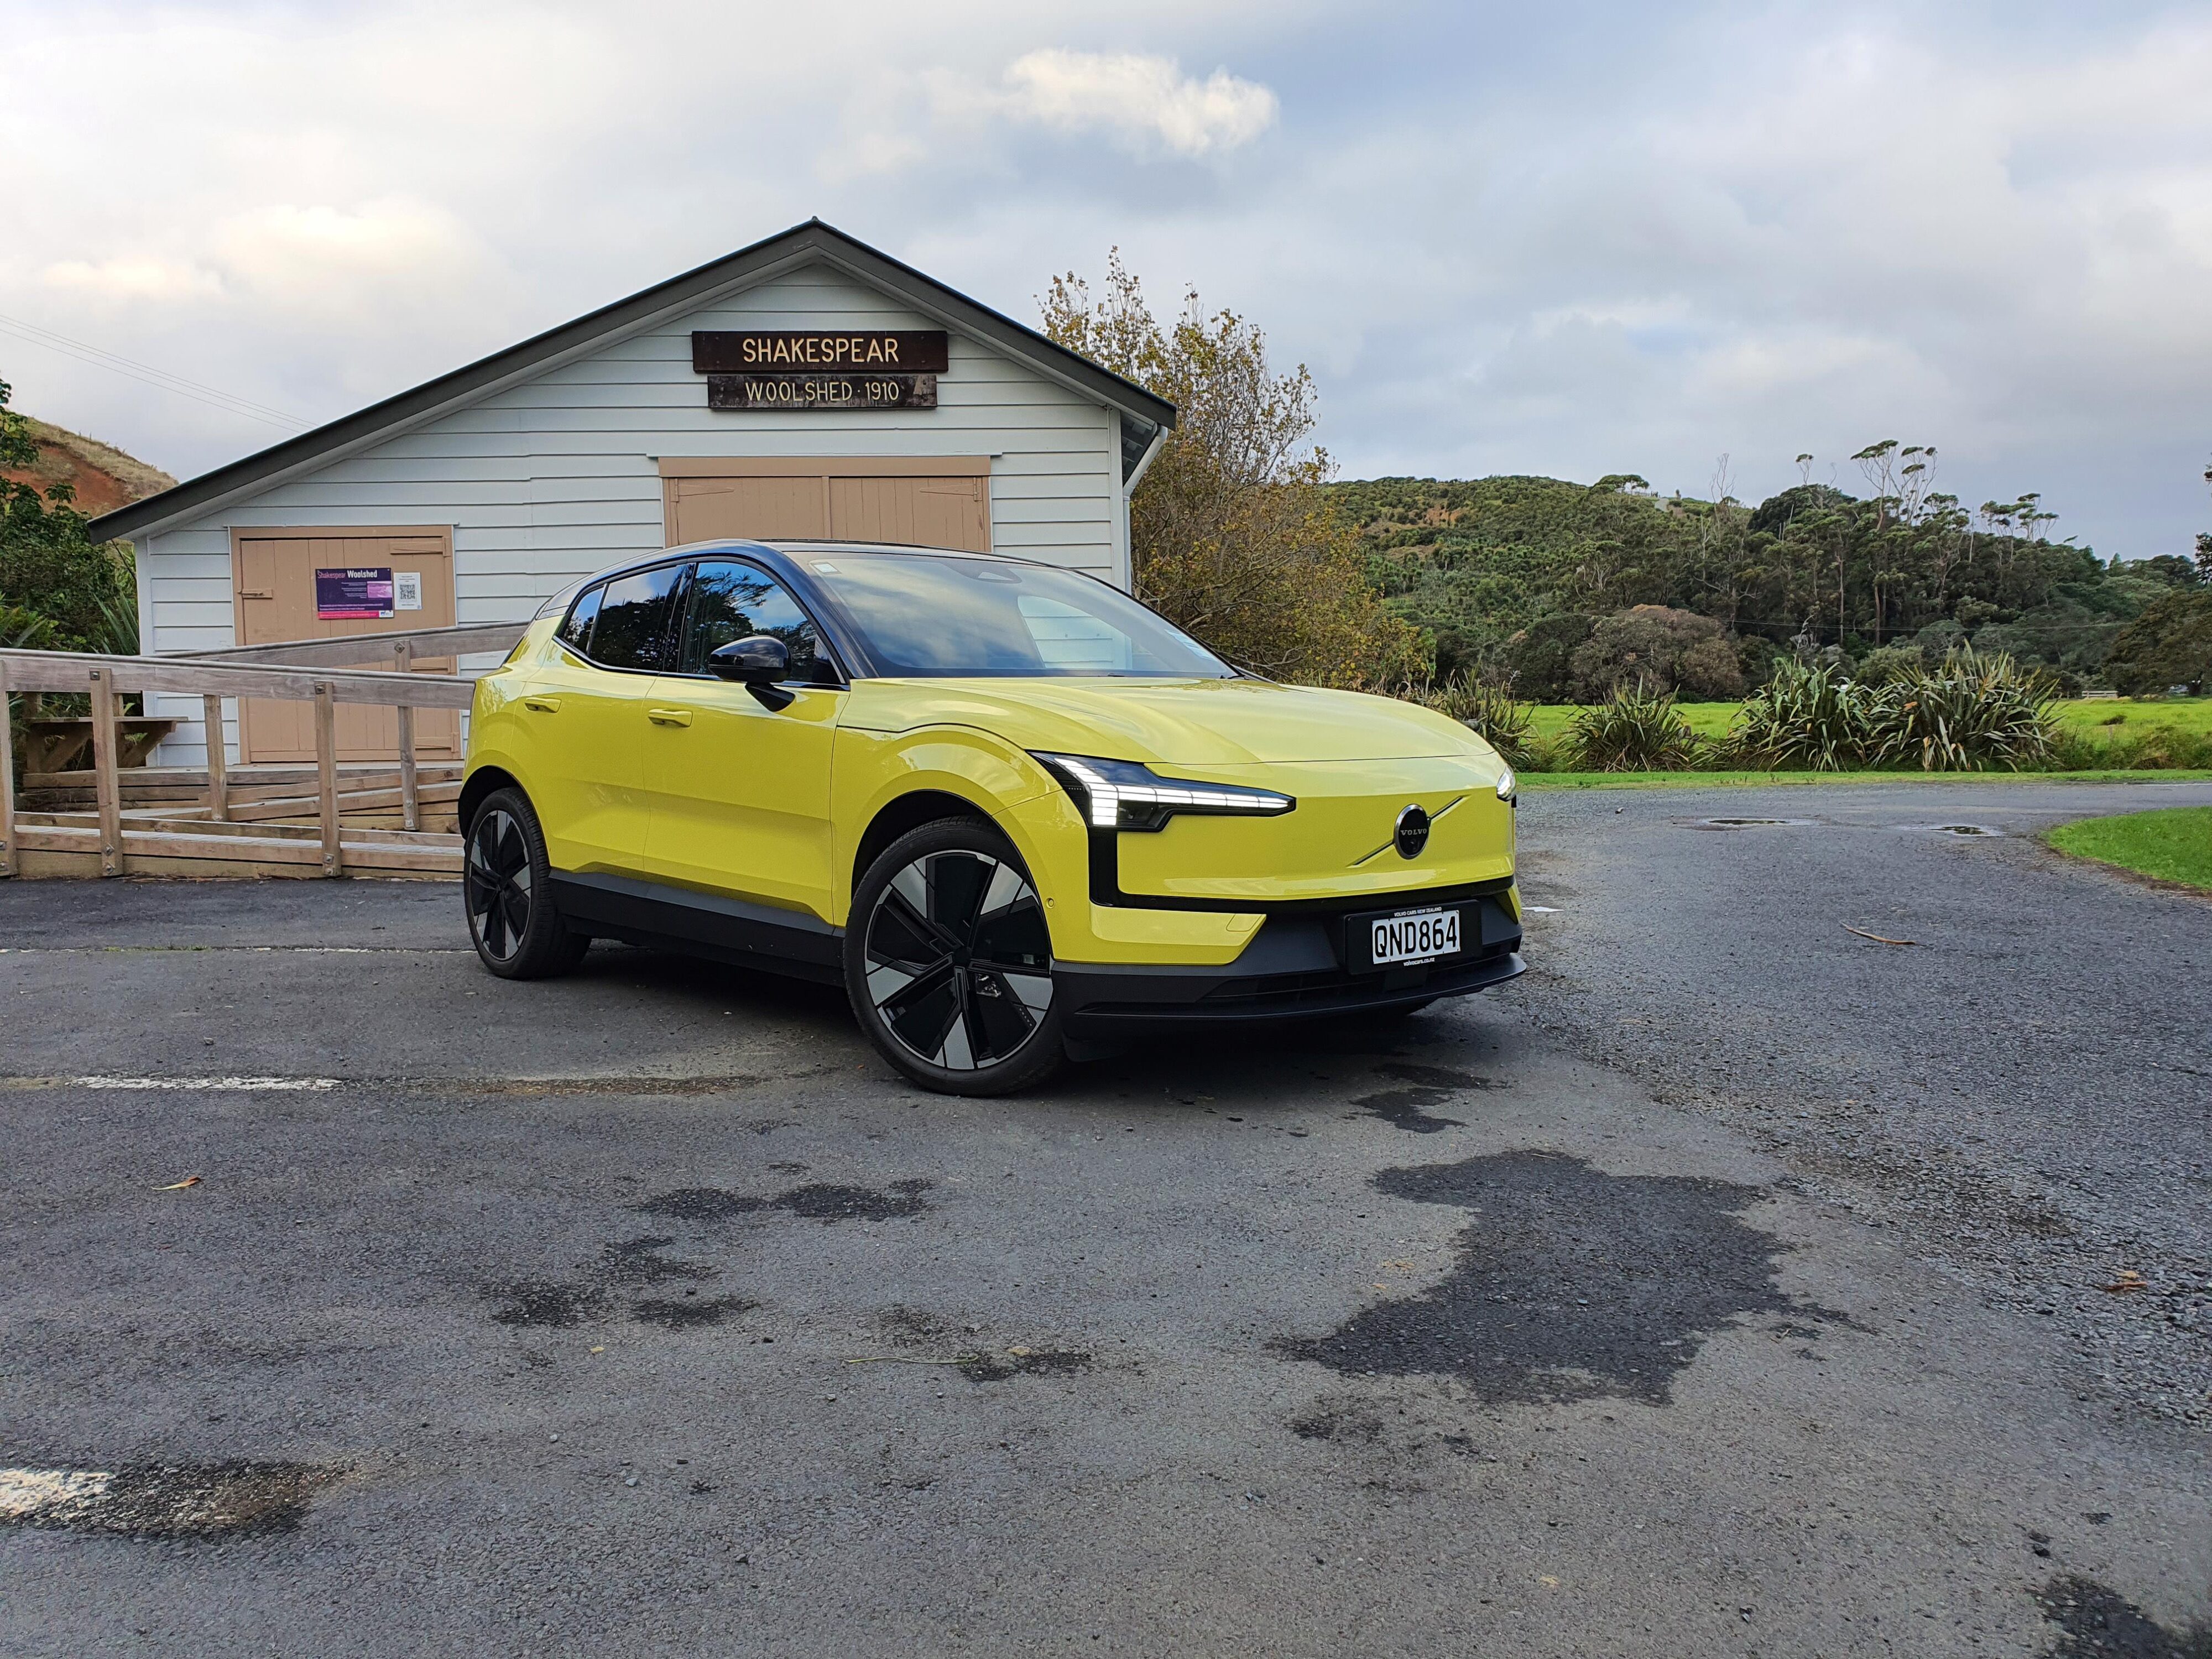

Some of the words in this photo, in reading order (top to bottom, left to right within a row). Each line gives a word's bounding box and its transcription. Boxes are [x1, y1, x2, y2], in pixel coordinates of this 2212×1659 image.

[742, 338, 899, 363] SHAKESPEAR
[745, 382, 853, 401] WOOLSHED
[865, 382, 900, 401] 1910
[347, 570, 377, 578] Woolshed
[1374, 916, 1457, 957] QND864
